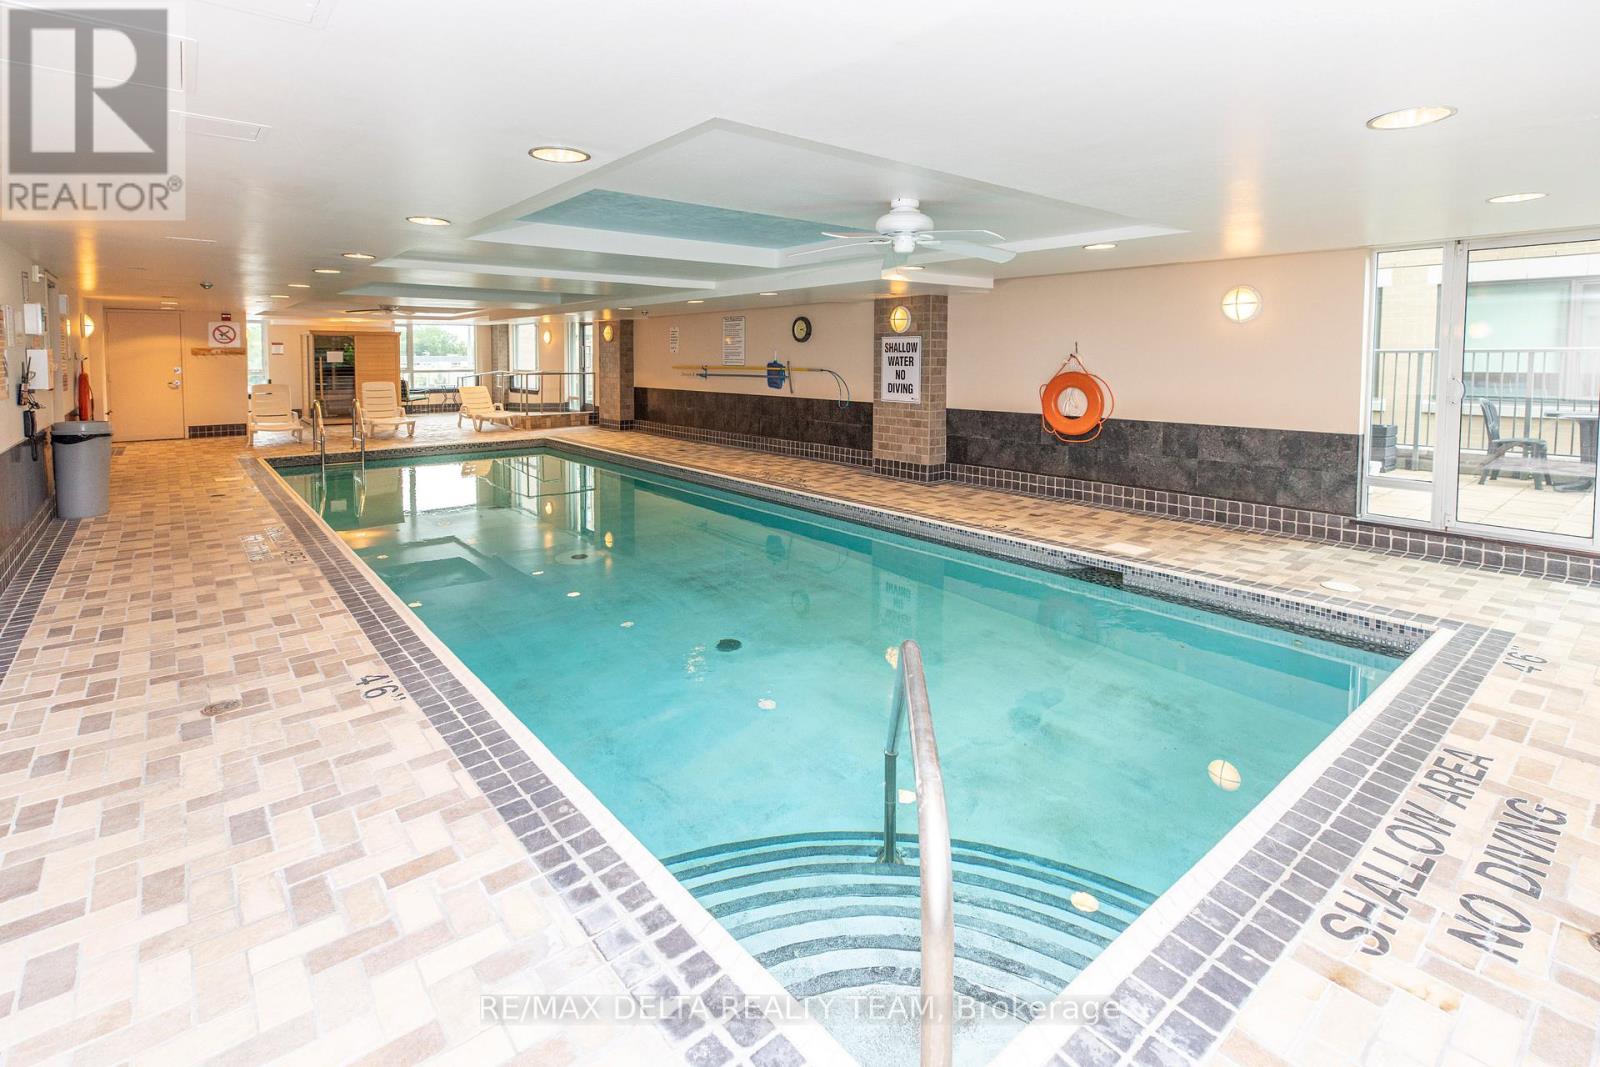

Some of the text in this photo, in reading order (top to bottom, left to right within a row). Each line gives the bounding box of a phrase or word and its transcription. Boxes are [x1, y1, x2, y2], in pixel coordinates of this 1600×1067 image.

[884, 342, 918, 353] SHALLOW
[887, 355, 914, 366] WATER
[895, 369, 906, 380] NO
[887, 382, 914, 394] DIVING
[1320, 747, 1495, 957] SHALLOW AREA
[1447, 797, 1568, 964] NO DIVING
